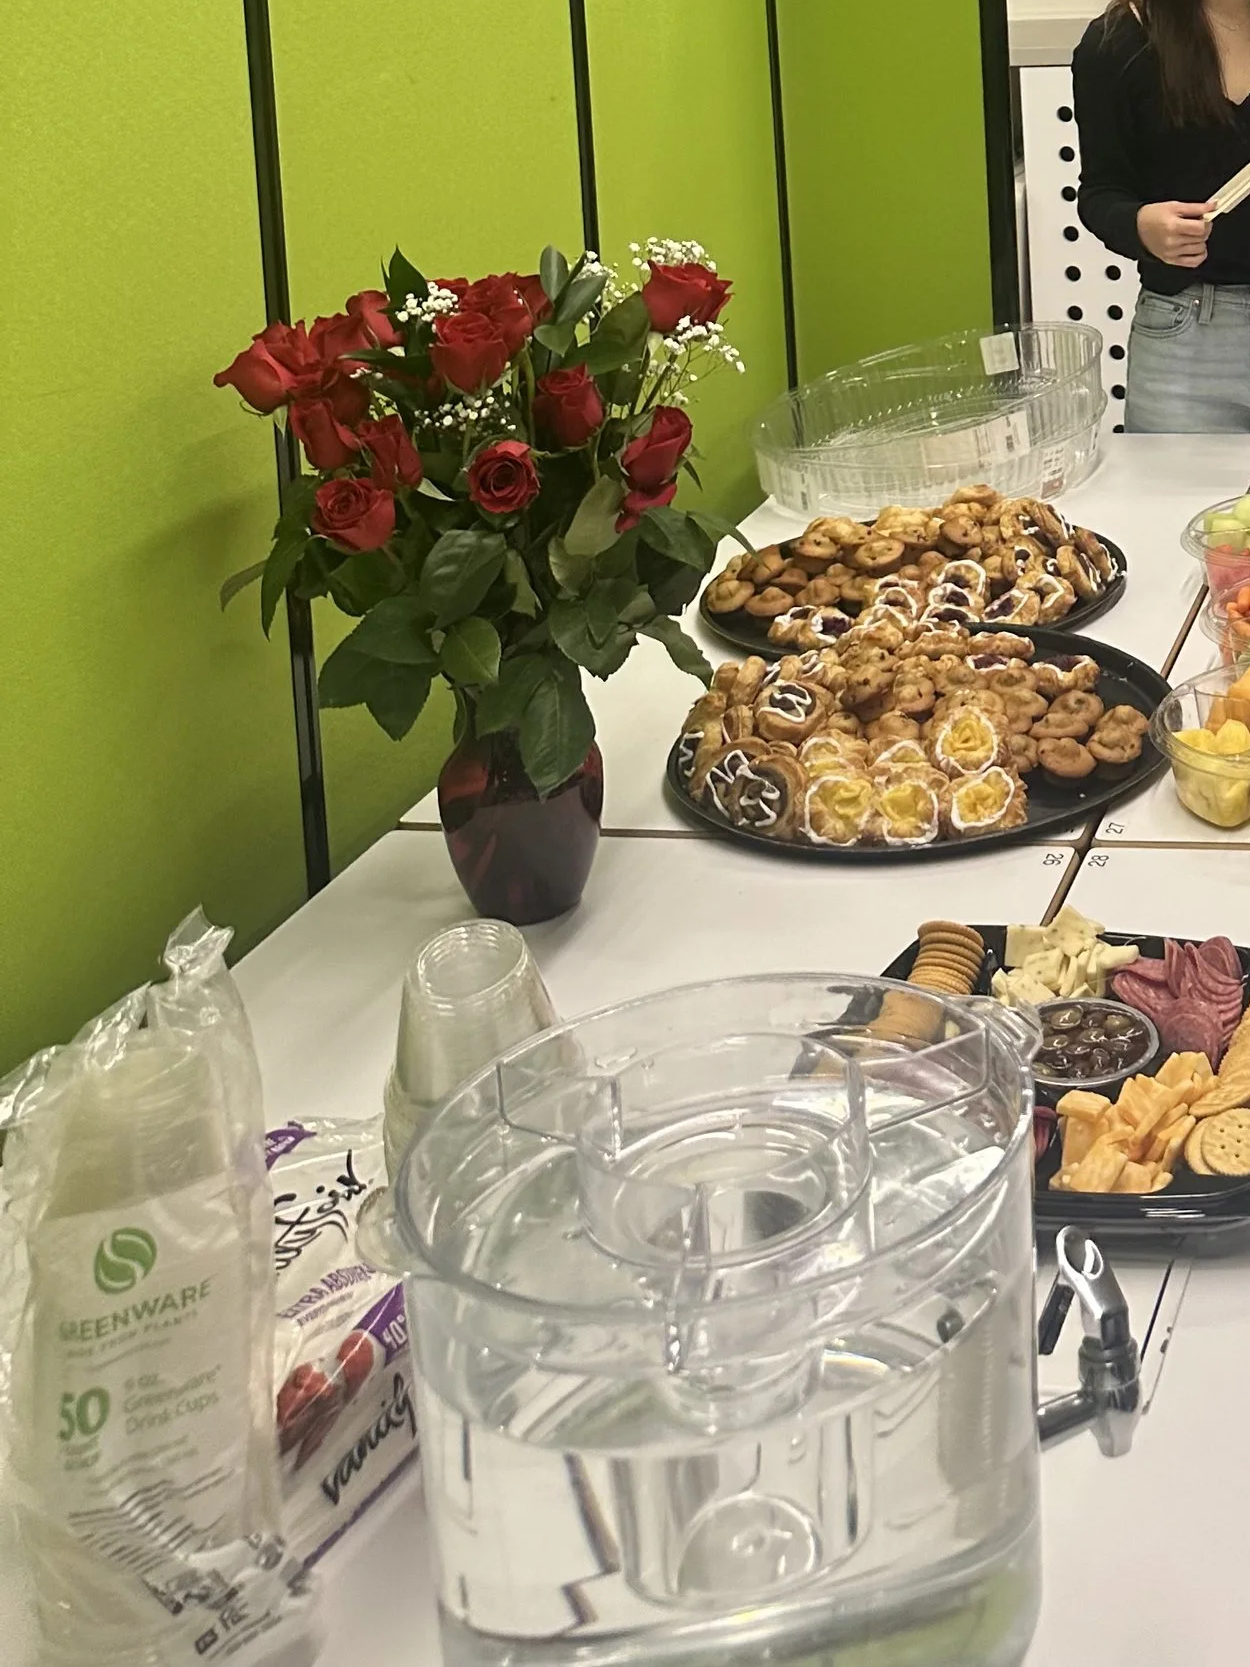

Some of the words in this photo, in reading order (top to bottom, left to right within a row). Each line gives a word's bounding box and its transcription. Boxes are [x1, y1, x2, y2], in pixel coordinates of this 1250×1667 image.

[1105, 822, 1125, 834] 27
[1042, 853, 1064, 866] 26
[1087, 855, 1109, 867] 28
[58, 1386, 111, 1442] 50
